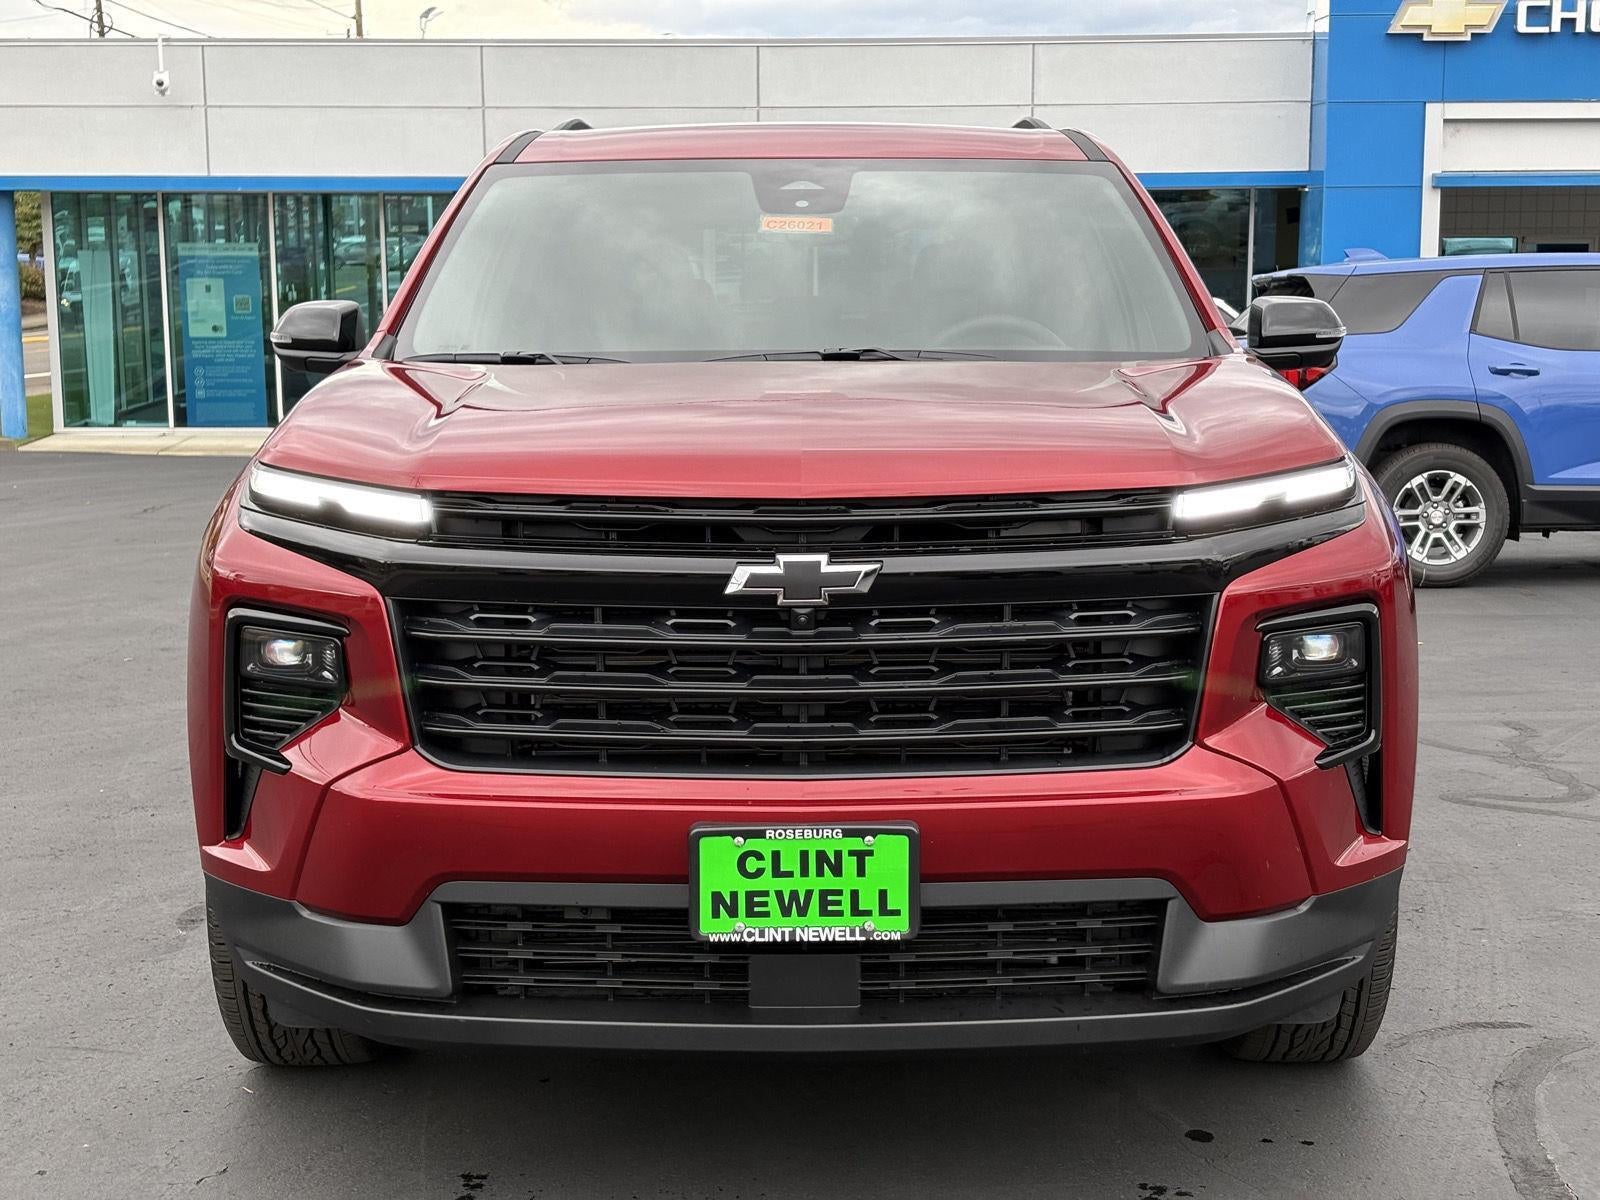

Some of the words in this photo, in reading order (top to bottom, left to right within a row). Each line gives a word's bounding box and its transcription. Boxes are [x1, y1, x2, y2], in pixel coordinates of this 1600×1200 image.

[766, 219, 823, 230] C26021
[765, 829, 843, 840] ROSEBURG
[736, 849, 875, 879] CLINT
[711, 889, 902, 919] NEWELL
